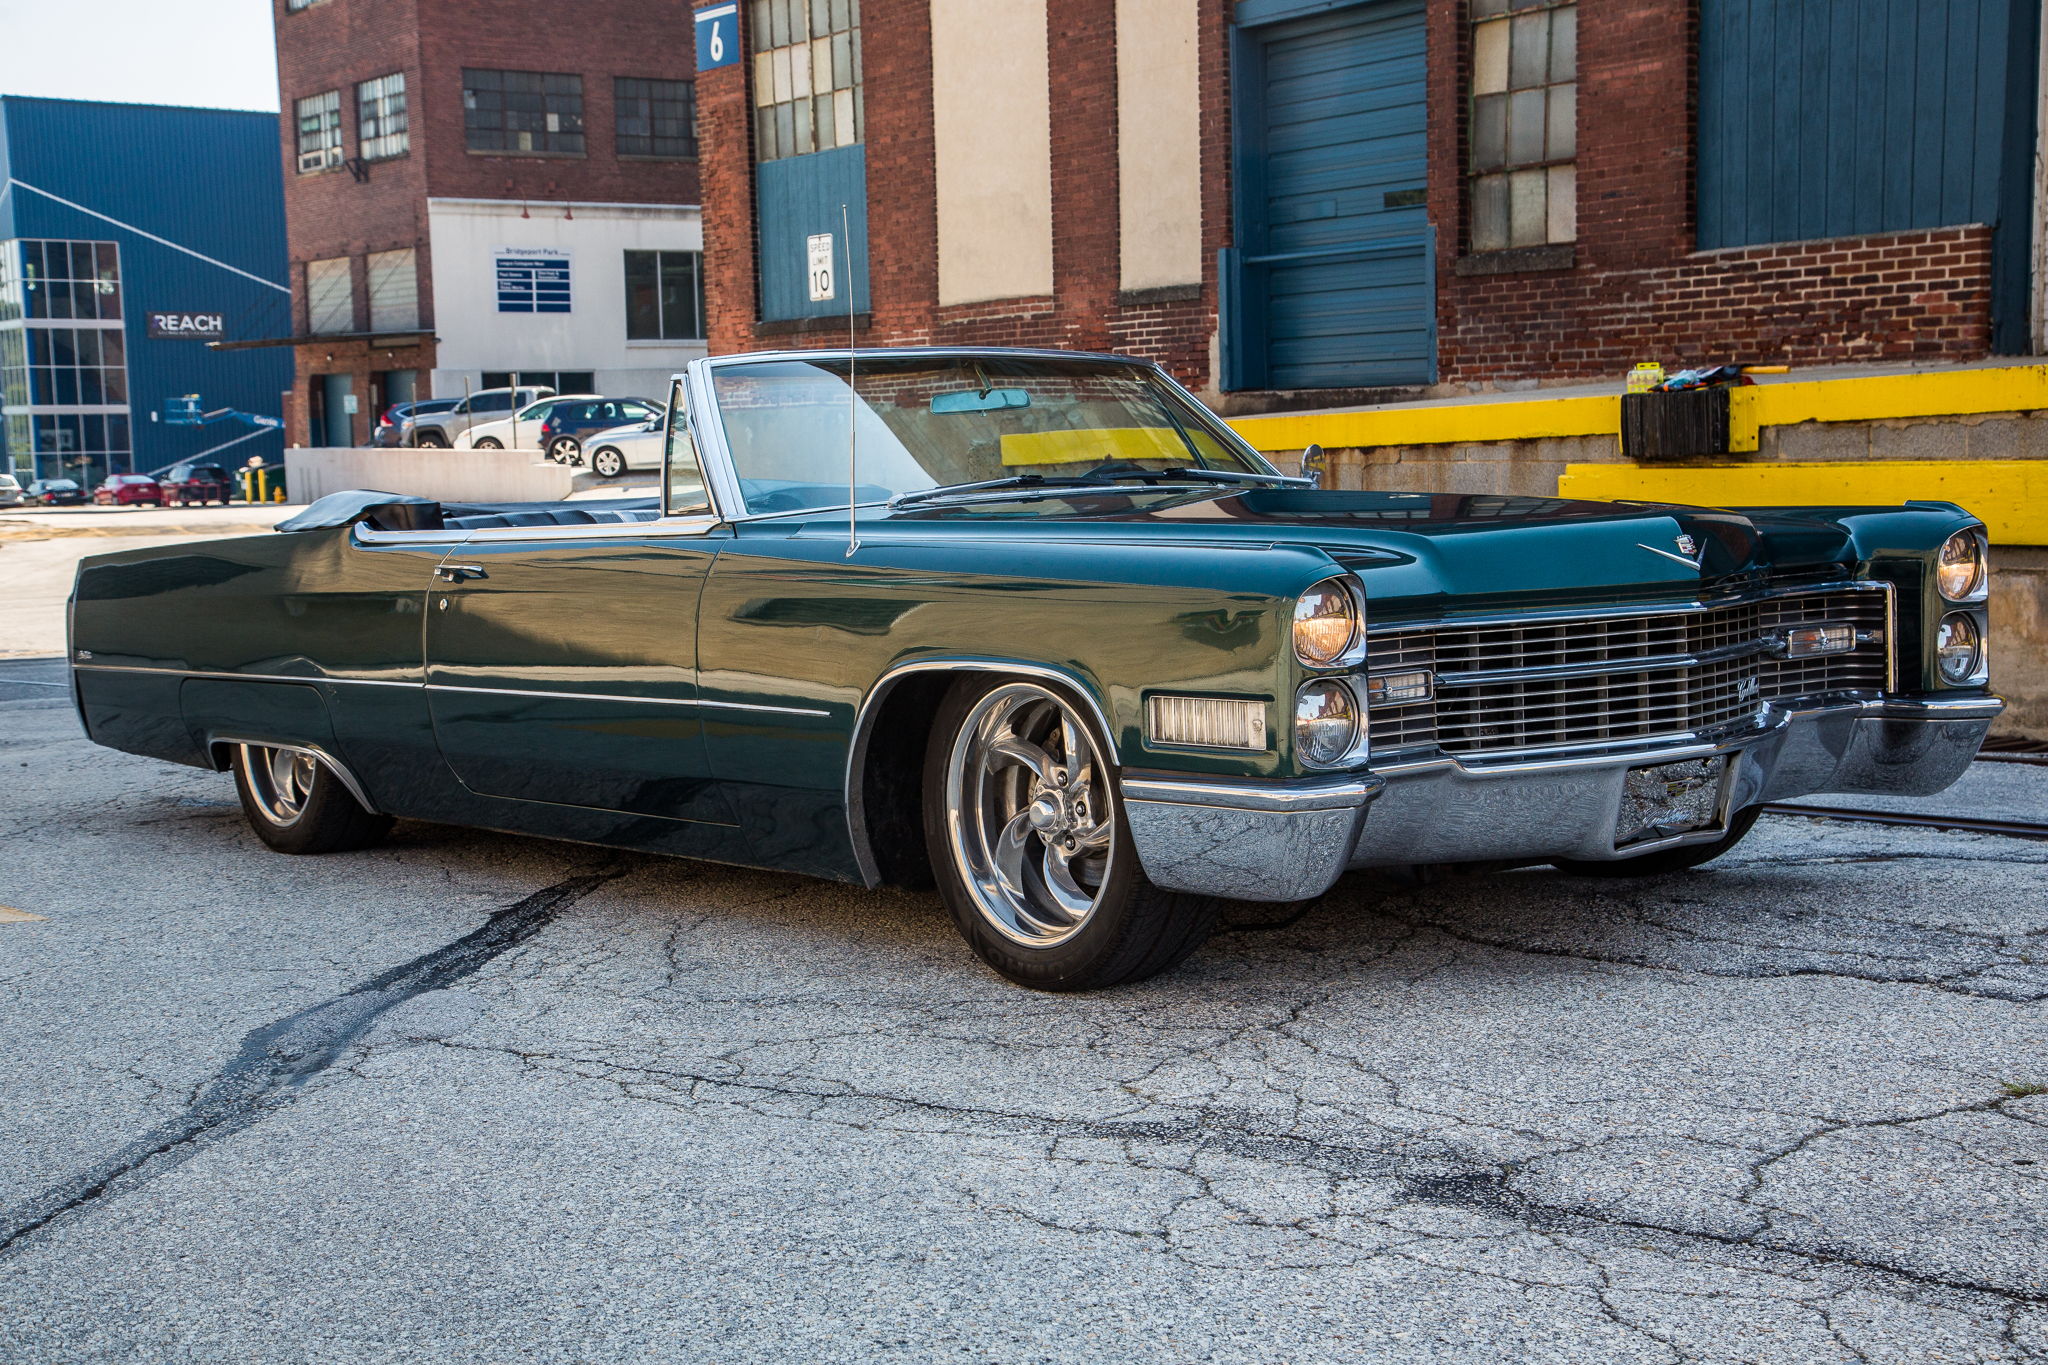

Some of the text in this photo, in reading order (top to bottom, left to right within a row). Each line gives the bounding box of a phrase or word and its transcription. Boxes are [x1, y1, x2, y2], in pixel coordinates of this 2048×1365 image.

[710, 20, 724, 62] 6
[505, 247, 541, 255] Bridgeport
[810, 241, 830, 252] SPEED
[813, 270, 829, 292] 10
[153, 314, 222, 331] REACH
